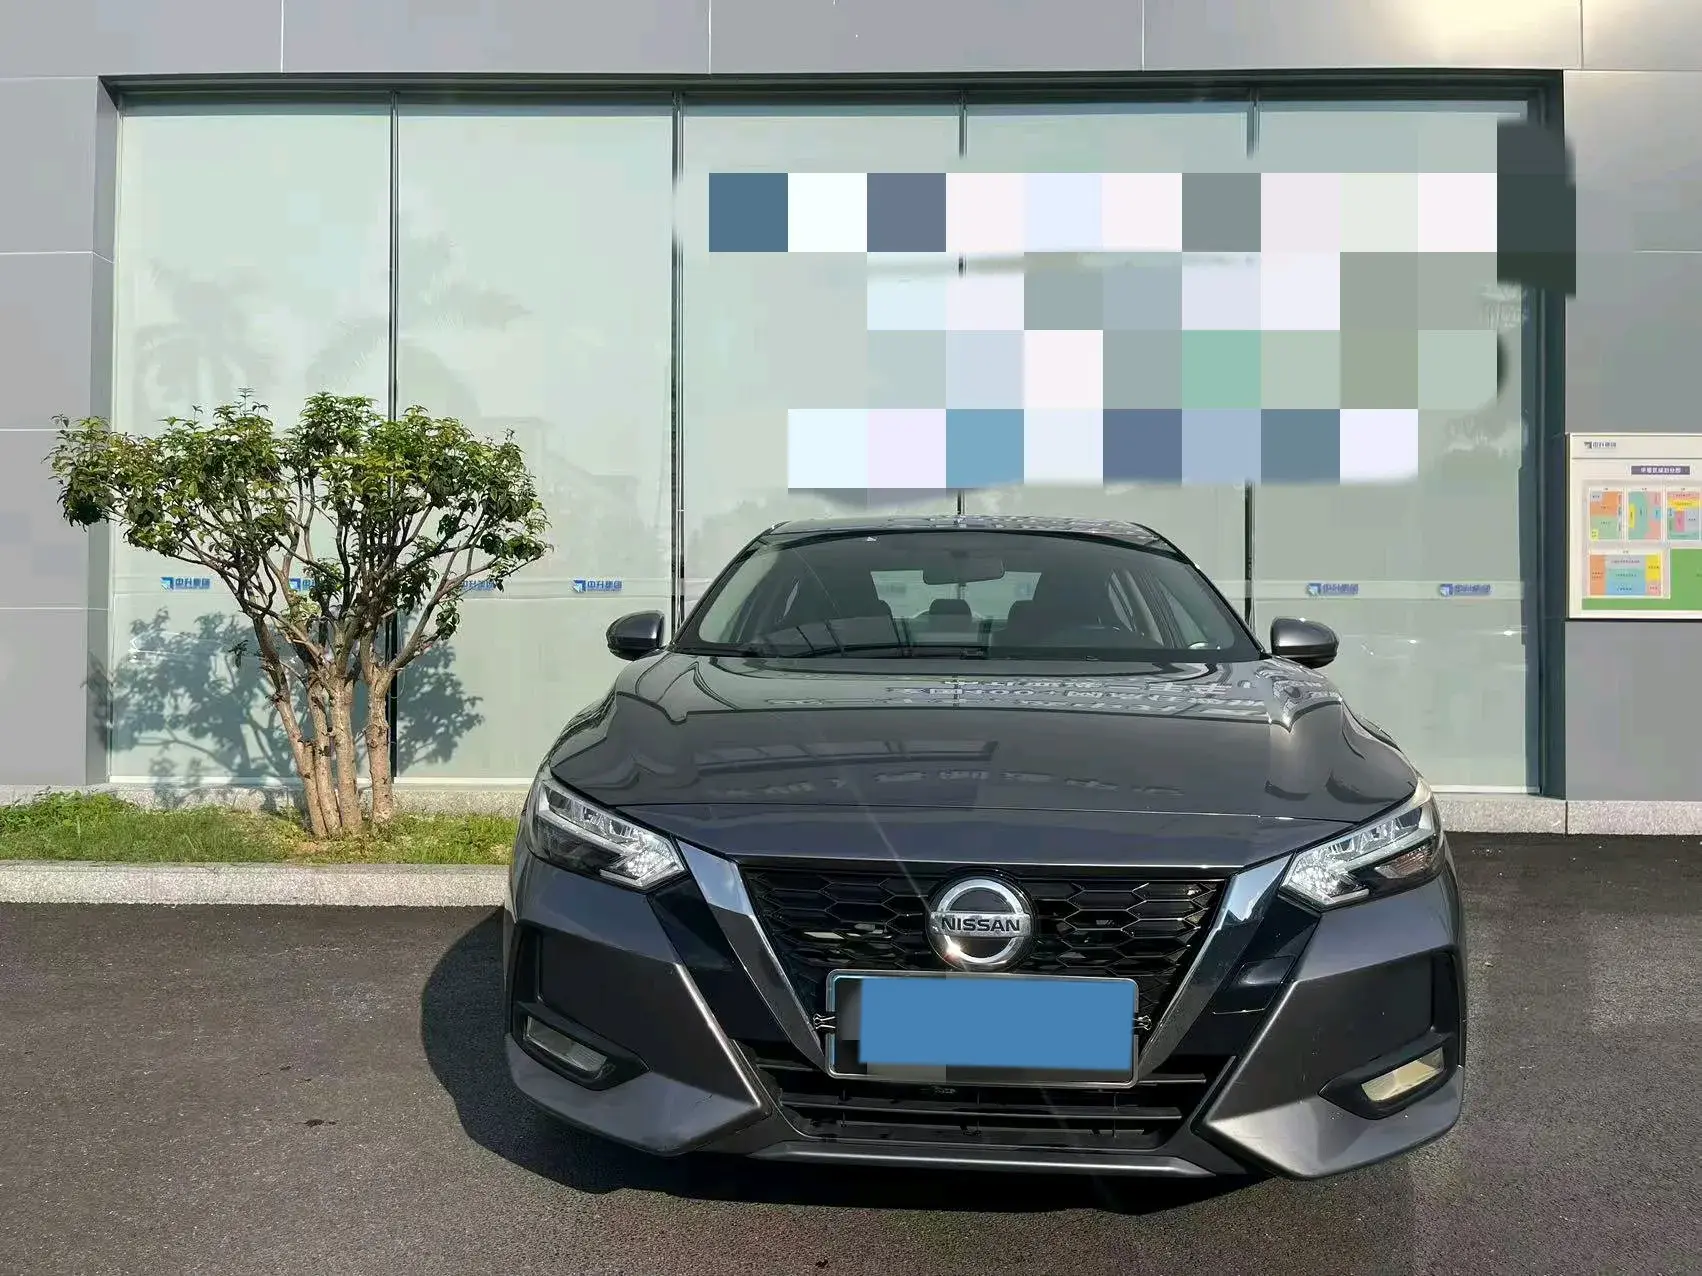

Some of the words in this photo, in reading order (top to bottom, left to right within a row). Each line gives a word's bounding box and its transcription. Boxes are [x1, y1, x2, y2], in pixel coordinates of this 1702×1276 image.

[587, 580, 622, 589] 中升集团
[941, 917, 1020, 932] NISSAN
